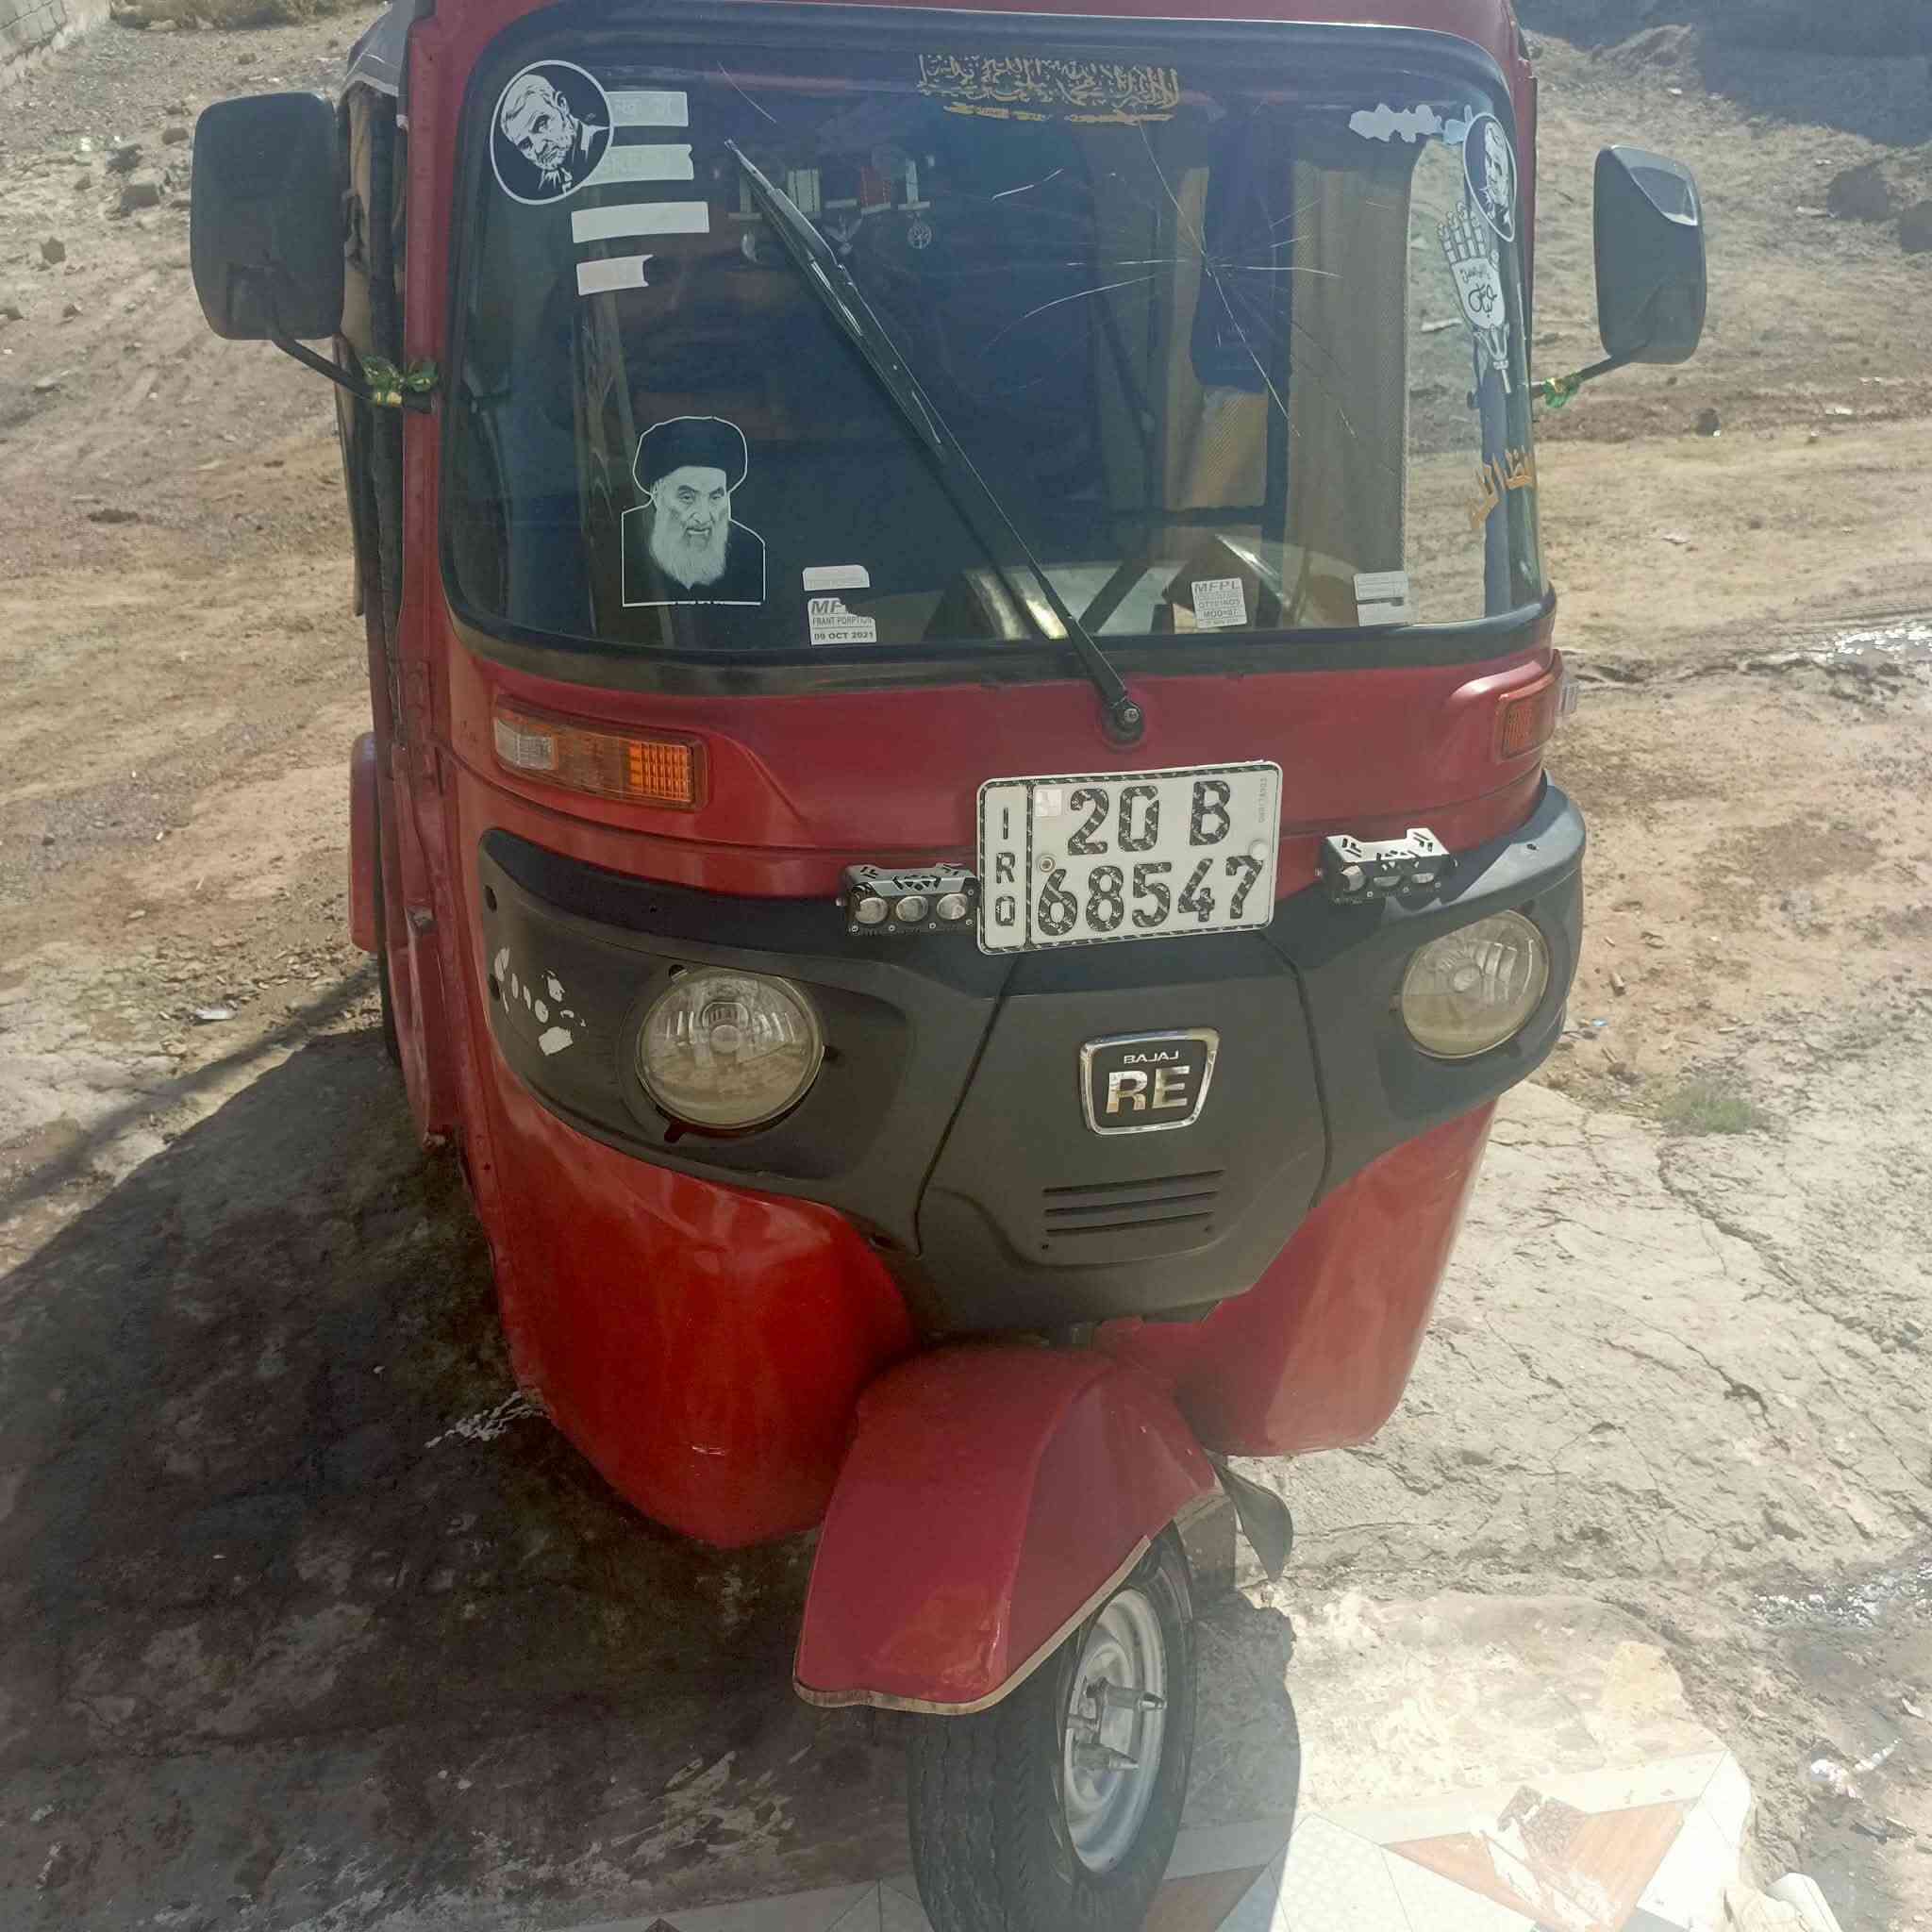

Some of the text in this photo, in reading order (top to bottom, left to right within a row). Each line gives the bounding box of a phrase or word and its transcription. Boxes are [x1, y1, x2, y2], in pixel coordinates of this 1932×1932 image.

[1067, 787, 1160, 856] 20
[1189, 780, 1231, 846] B
[1037, 854, 1264, 937] 68547
[1123, 1050, 1180, 1064] BAJAJ
[1105, 1065, 1191, 1114] RE
